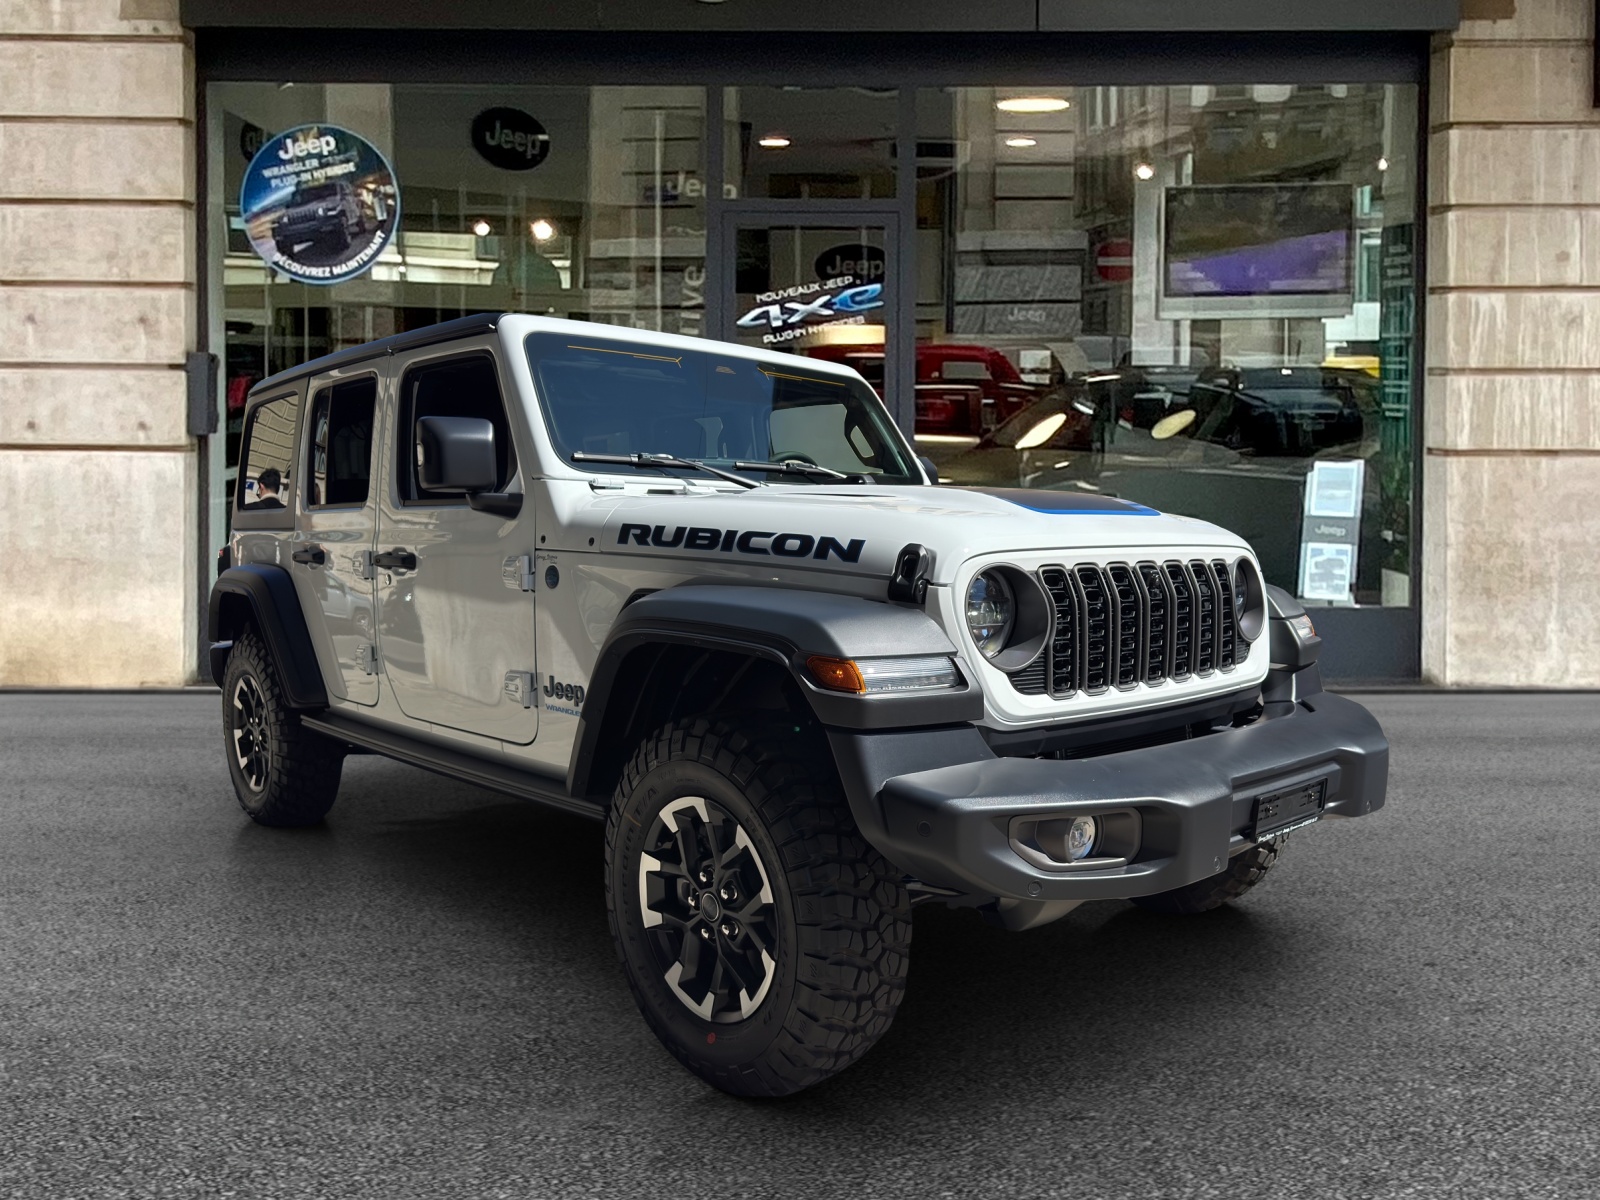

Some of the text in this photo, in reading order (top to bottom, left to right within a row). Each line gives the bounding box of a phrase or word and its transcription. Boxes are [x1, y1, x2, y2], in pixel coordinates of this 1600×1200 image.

[278, 135, 336, 160] Jeep
[485, 120, 541, 159] Jeep
[262, 158, 320, 178] WRANGLER
[270, 172, 312, 188] PLUG-IN
[332, 230, 386, 275] MAINTENANT
[827, 255, 884, 278] Jeep
[756, 275, 853, 303] NOUVEAUX JEEP
[617, 523, 866, 564] RUBICON
[1315, 524, 1346, 537] Jeep
[543, 675, 585, 707] Jeep
